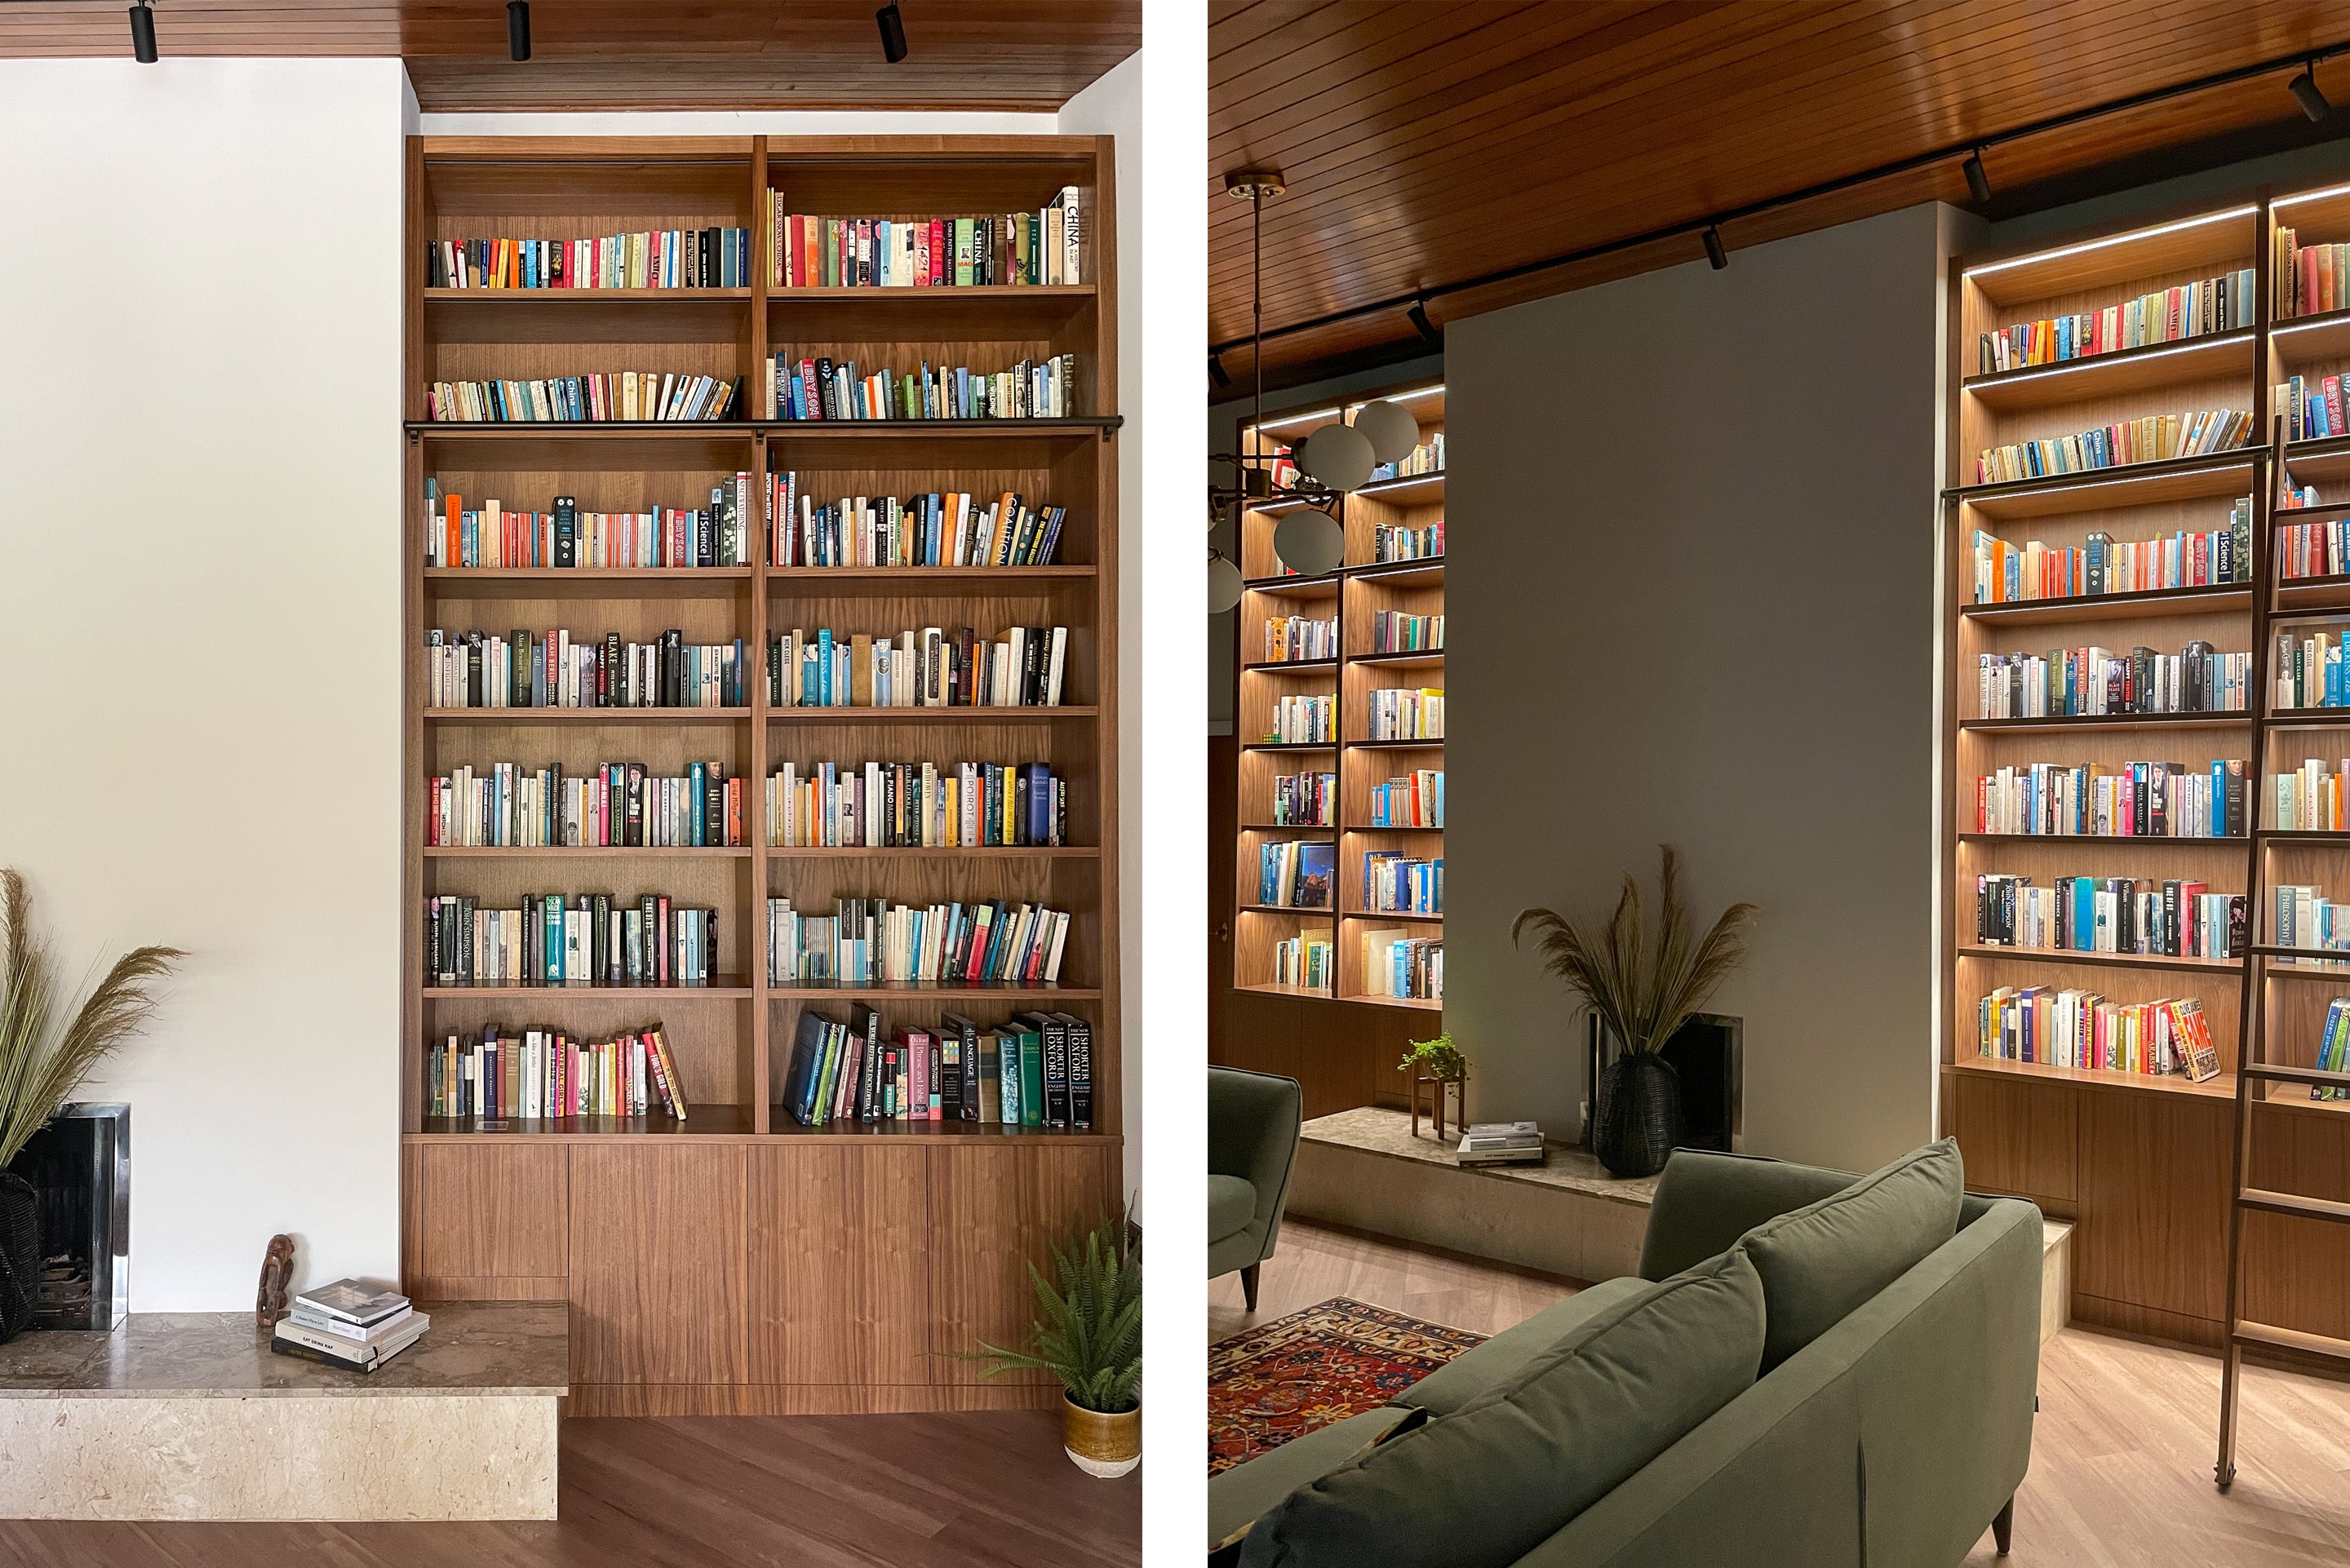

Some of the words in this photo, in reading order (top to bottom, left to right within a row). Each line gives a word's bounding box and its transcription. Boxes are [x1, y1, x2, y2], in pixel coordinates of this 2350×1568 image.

[1067, 206, 1078, 246] CHINA
[805, 368, 819, 416] BRYSON
[737, 481, 745, 530] SPACEWATCHING
[675, 519, 684, 559] BRYSON
[700, 520, 709, 554] Science
[999, 498, 1017, 564] COALITION
[2196, 542, 2204, 577] BRYSON
[2219, 540, 2228, 570] Science
[609, 636, 618, 664] BLAKE
[463, 907, 471, 926] JOHN
[2281, 895, 2290, 939] PHILOSOPHY
[463, 927, 471, 958] SIMPSON
[966, 1038, 974, 1077] LANGUAGE
[1047, 1036, 1056, 1079] OXFORD
[1056, 1035, 1064, 1079] SHORTER
[1071, 1037, 1081, 1081] OXFORD
[1080, 1037, 1089, 1079] SHORTER
